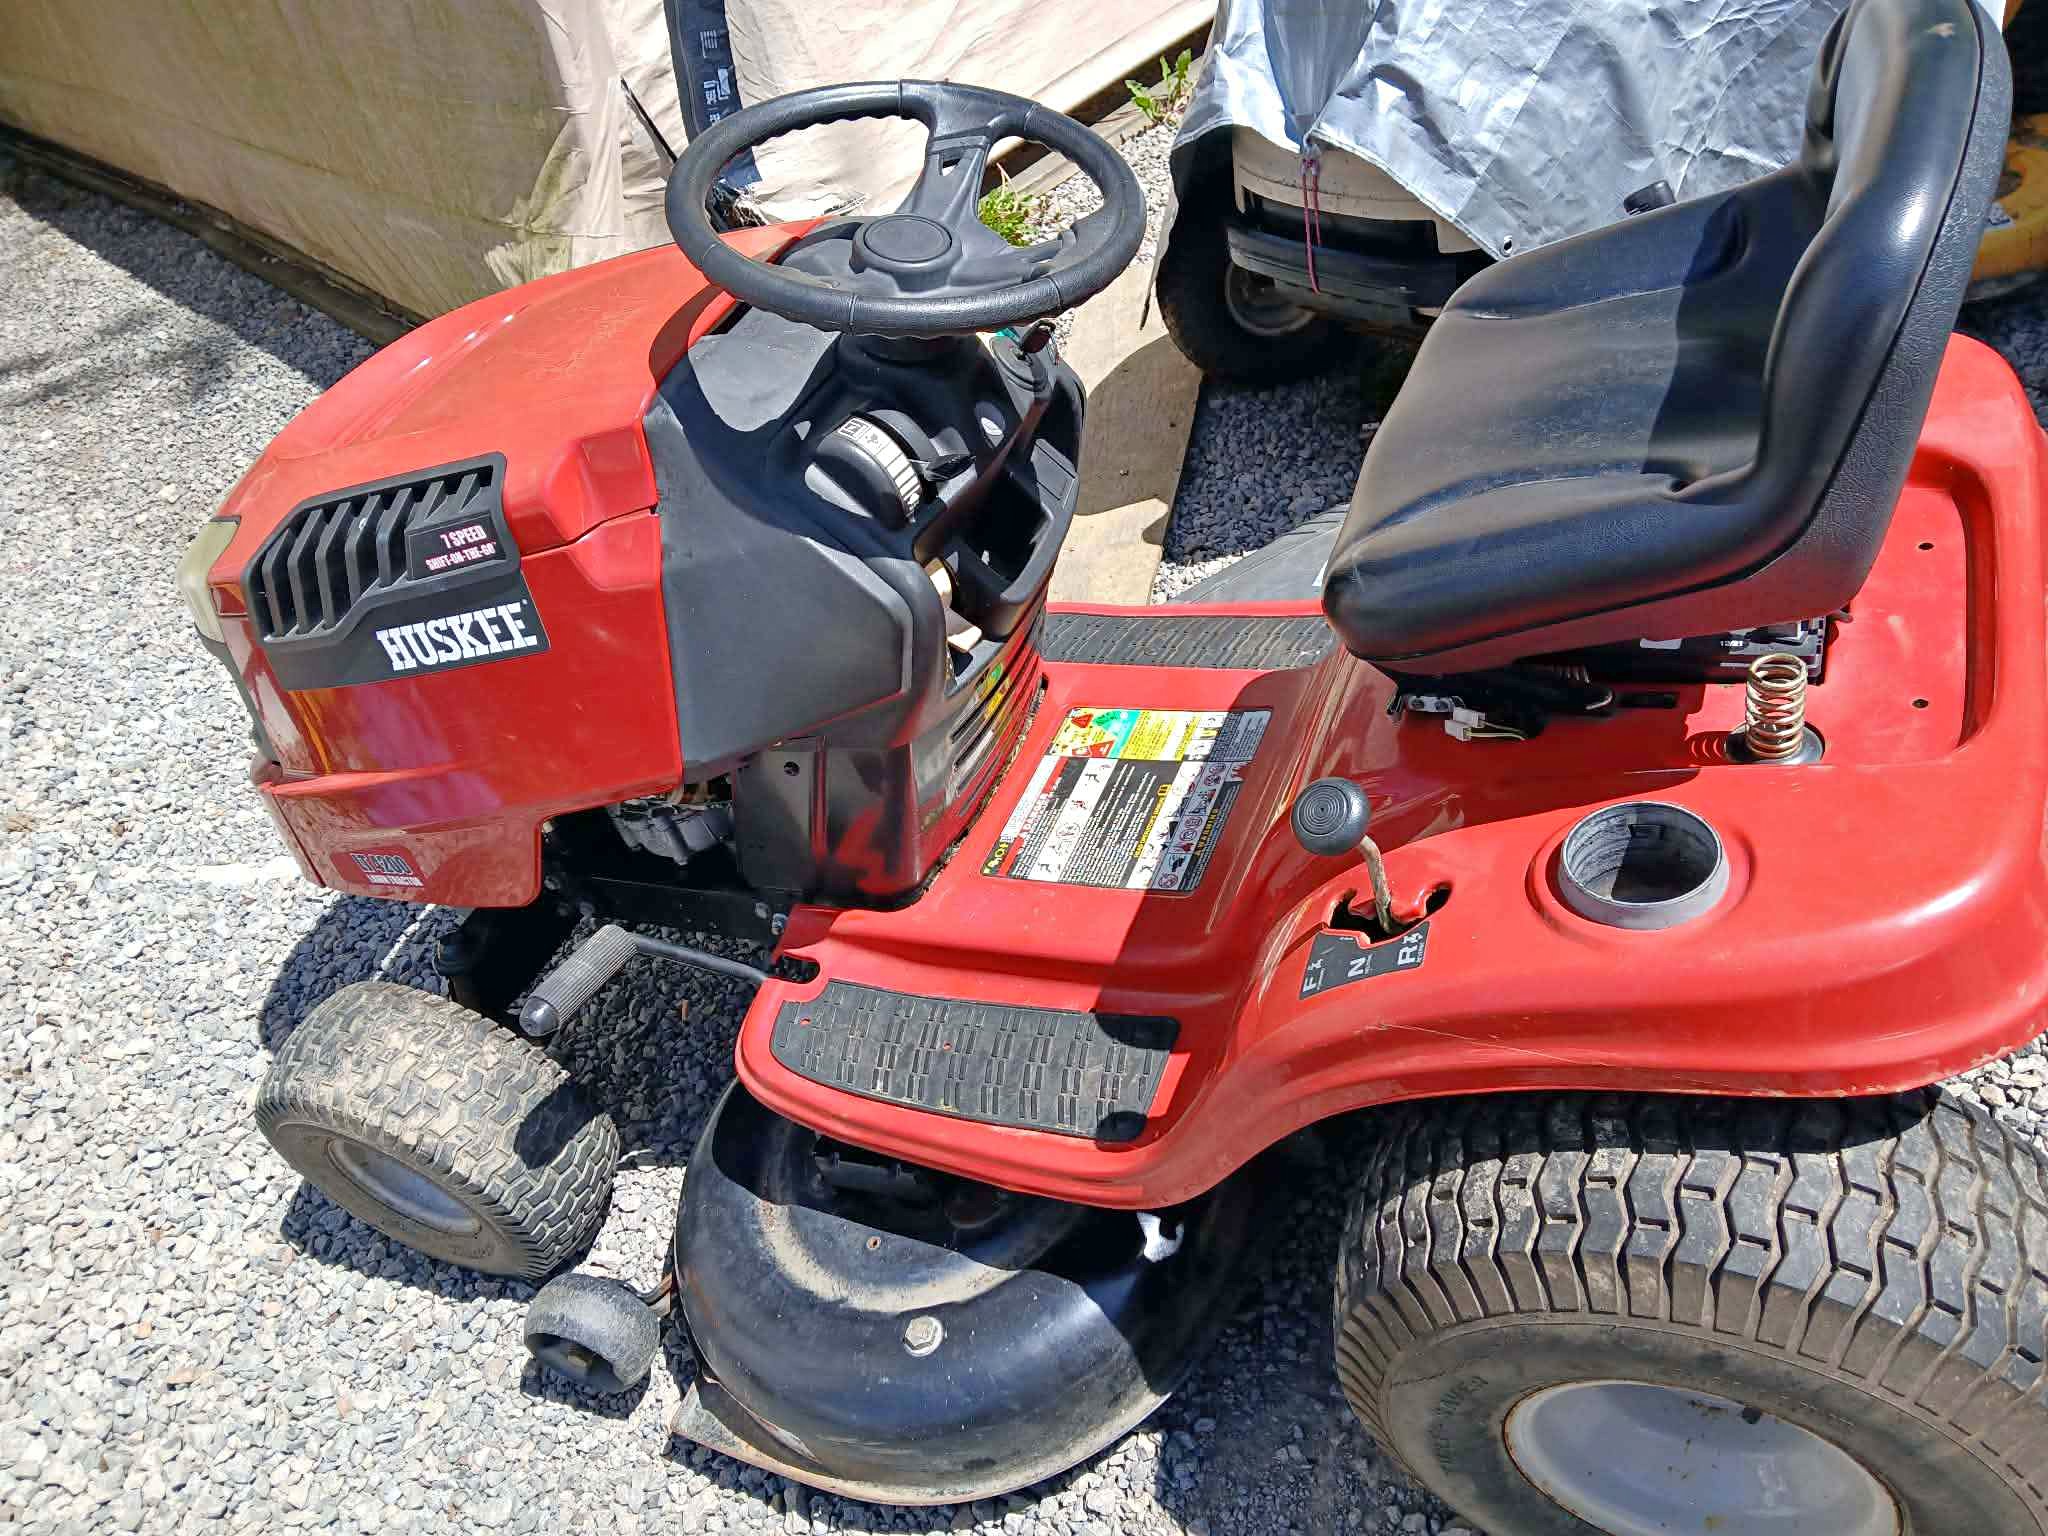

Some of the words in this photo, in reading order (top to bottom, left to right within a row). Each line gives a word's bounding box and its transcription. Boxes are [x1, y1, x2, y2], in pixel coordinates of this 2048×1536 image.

[451, 525, 487, 546] SPEED
[375, 602, 537, 671] HUSKEE
[1398, 946, 1417, 965] R
[1347, 957, 1366, 977] N
[1303, 976, 1317, 992] F
